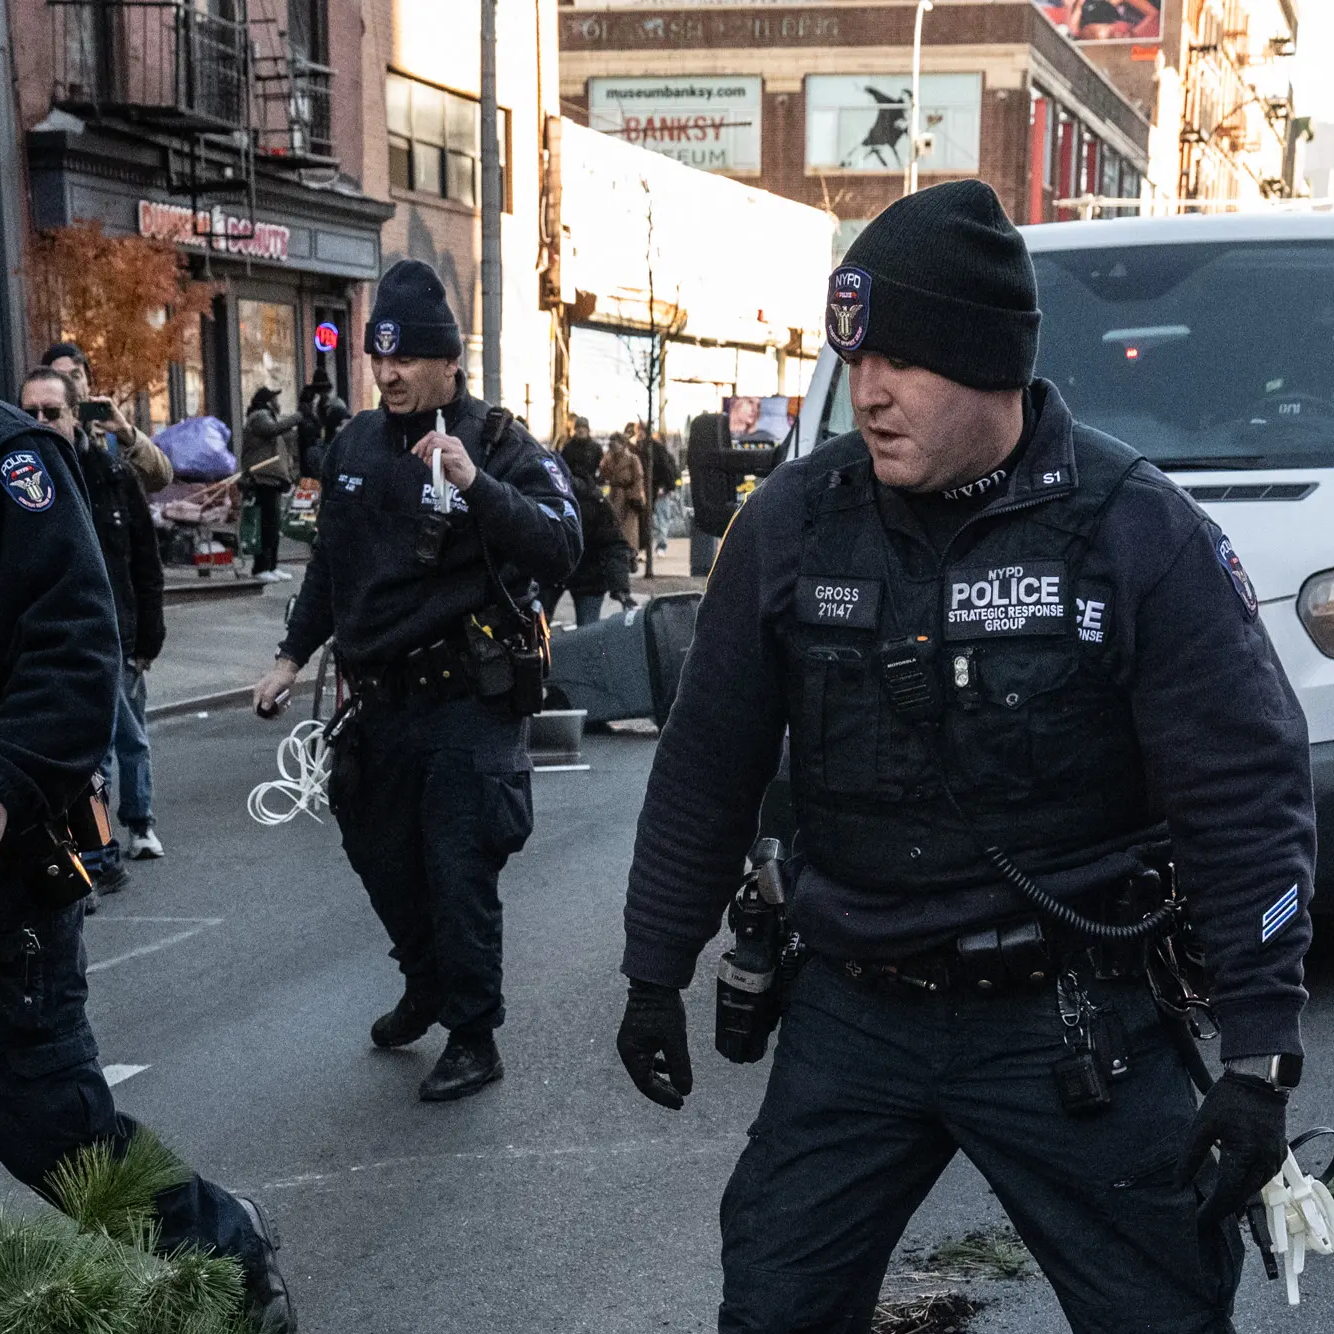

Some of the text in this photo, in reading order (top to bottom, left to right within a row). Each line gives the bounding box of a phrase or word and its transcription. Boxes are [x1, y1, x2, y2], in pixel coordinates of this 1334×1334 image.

[606, 85, 746, 99] museumbanksy.com
[624, 115, 725, 142] BANKSY
[835, 273, 861, 288] NYPD
[0, 454, 36, 477] POLICE
[1042, 470, 1061, 484] S1
[988, 566, 1023, 581] NYPD
[815, 585, 860, 602] GROSS
[951, 576, 1060, 610] POLICE
[818, 602, 854, 620] 21147
[948, 607, 1006, 623] STRATEGIC
[1007, 604, 1064, 619] RESPONSE
[984, 617, 1026, 632] GROUP
[887, 657, 917, 668] MOTOROLA
